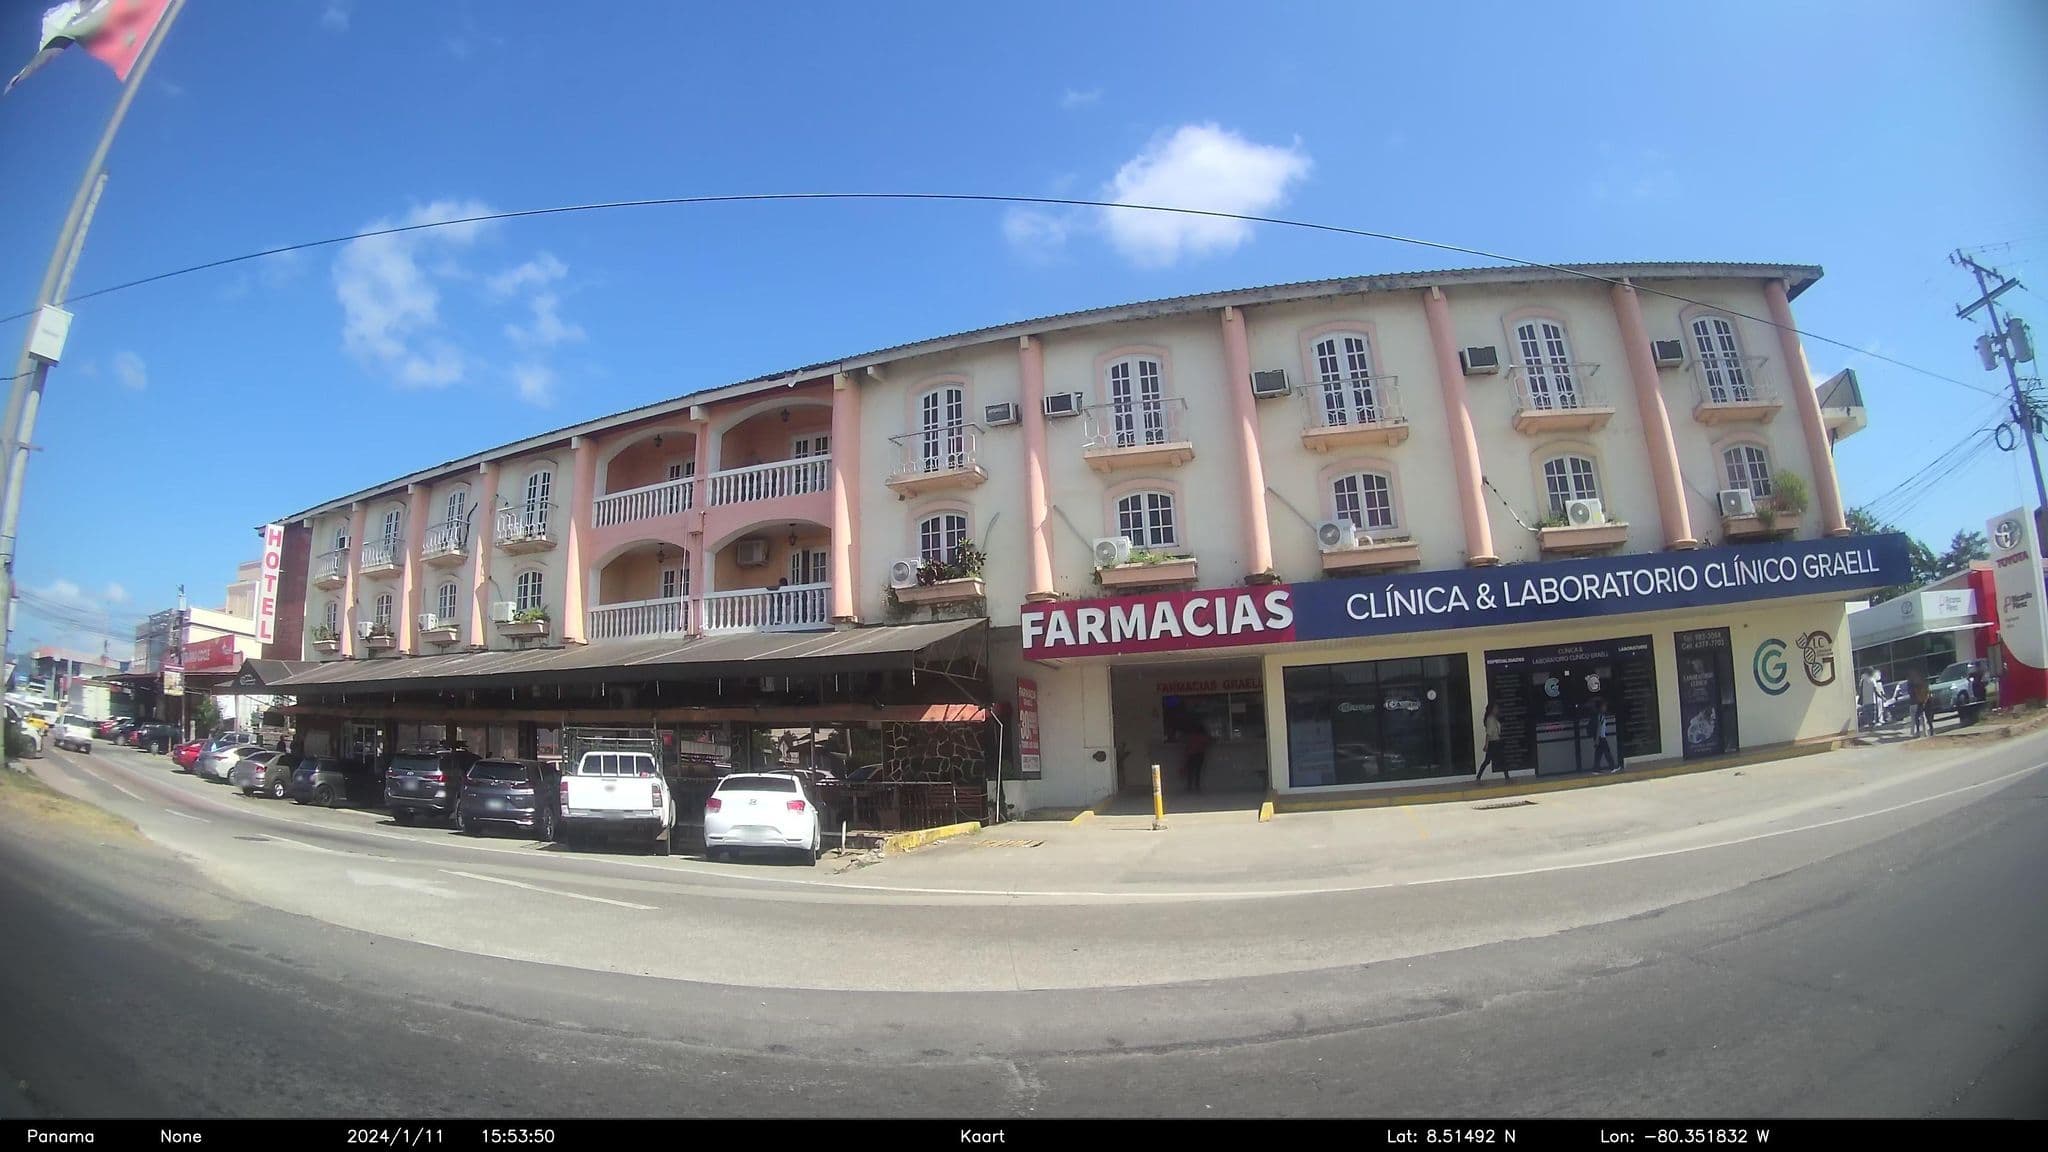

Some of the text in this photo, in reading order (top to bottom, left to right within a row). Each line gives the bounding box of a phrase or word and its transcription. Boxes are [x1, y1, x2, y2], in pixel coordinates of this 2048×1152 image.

[260, 528, 282, 639] HOTEL
[1346, 549, 1880, 620] CLÍNICA & LABORATORIO CLÍNICO GRAELL
[1021, 590, 1294, 649] FARMACIAS
